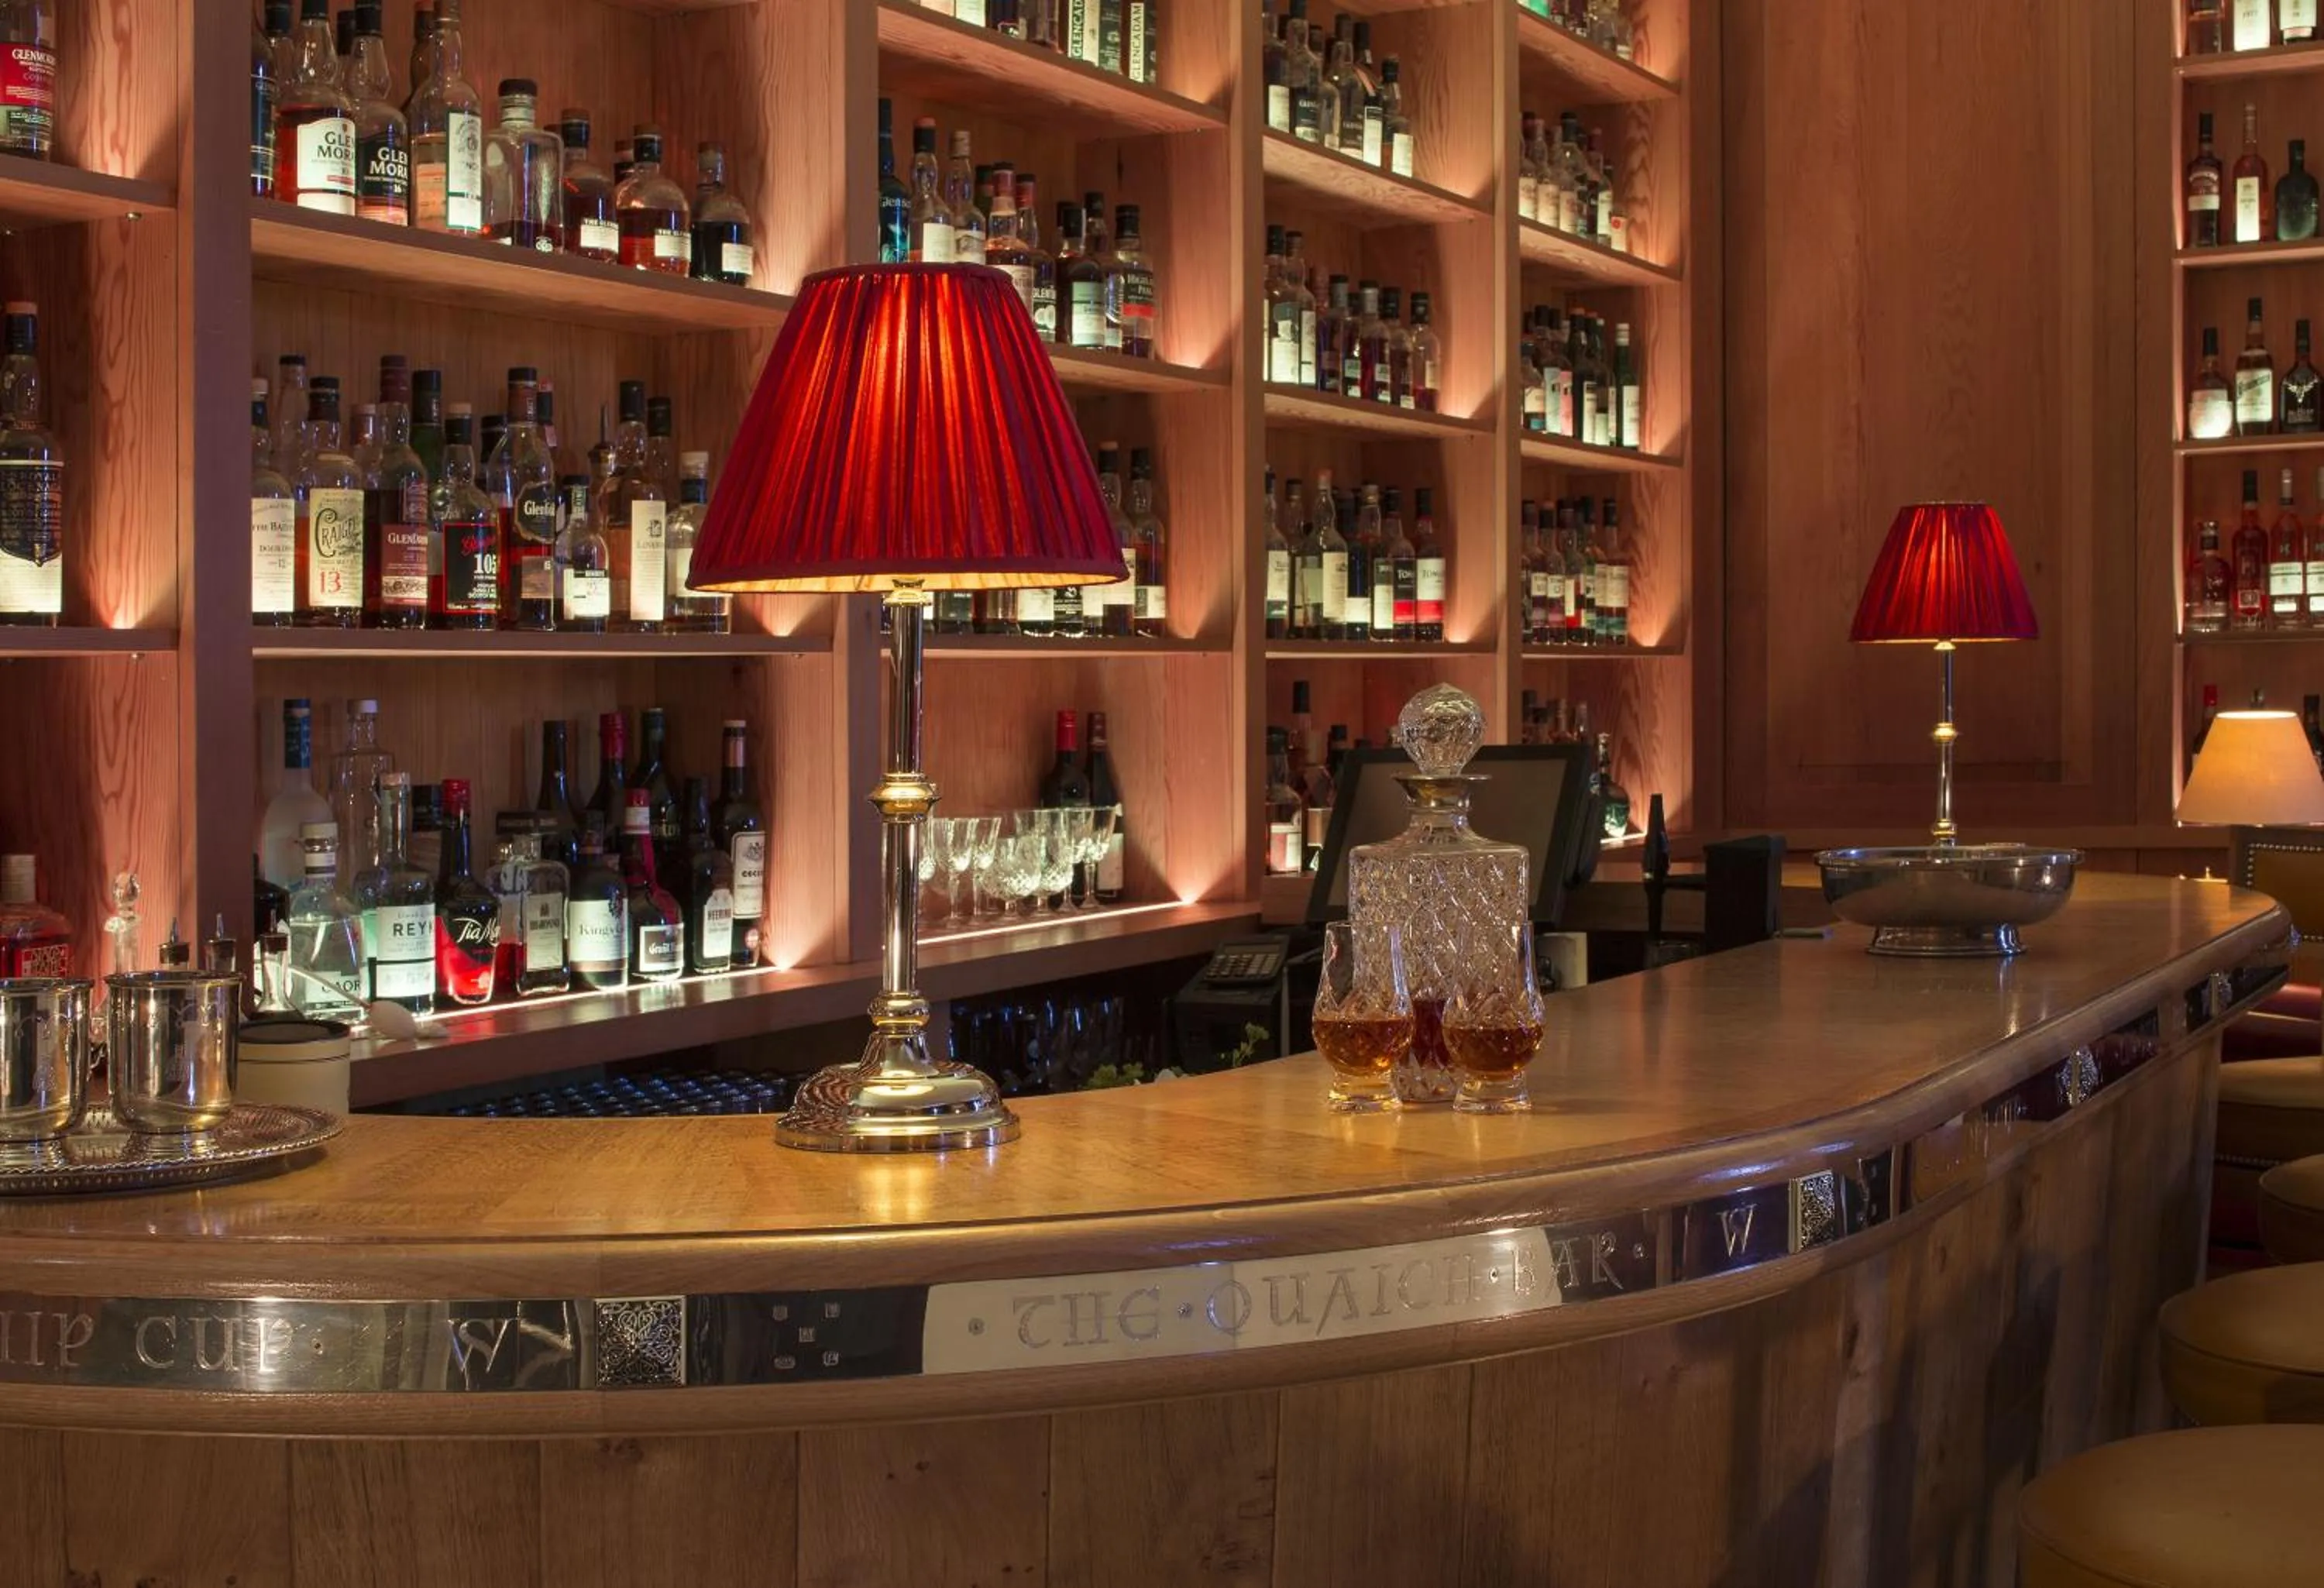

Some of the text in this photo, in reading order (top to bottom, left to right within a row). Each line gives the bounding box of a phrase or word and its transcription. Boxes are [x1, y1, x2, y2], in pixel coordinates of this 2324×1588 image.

[1132, 4, 1143, 80] GLENCADAM
[320, 569, 342, 596] 13
[393, 922, 433, 937] REY
[1013, 1231, 1624, 1349] THE QUAICH BAR
[135, 1315, 294, 1373] CUP
